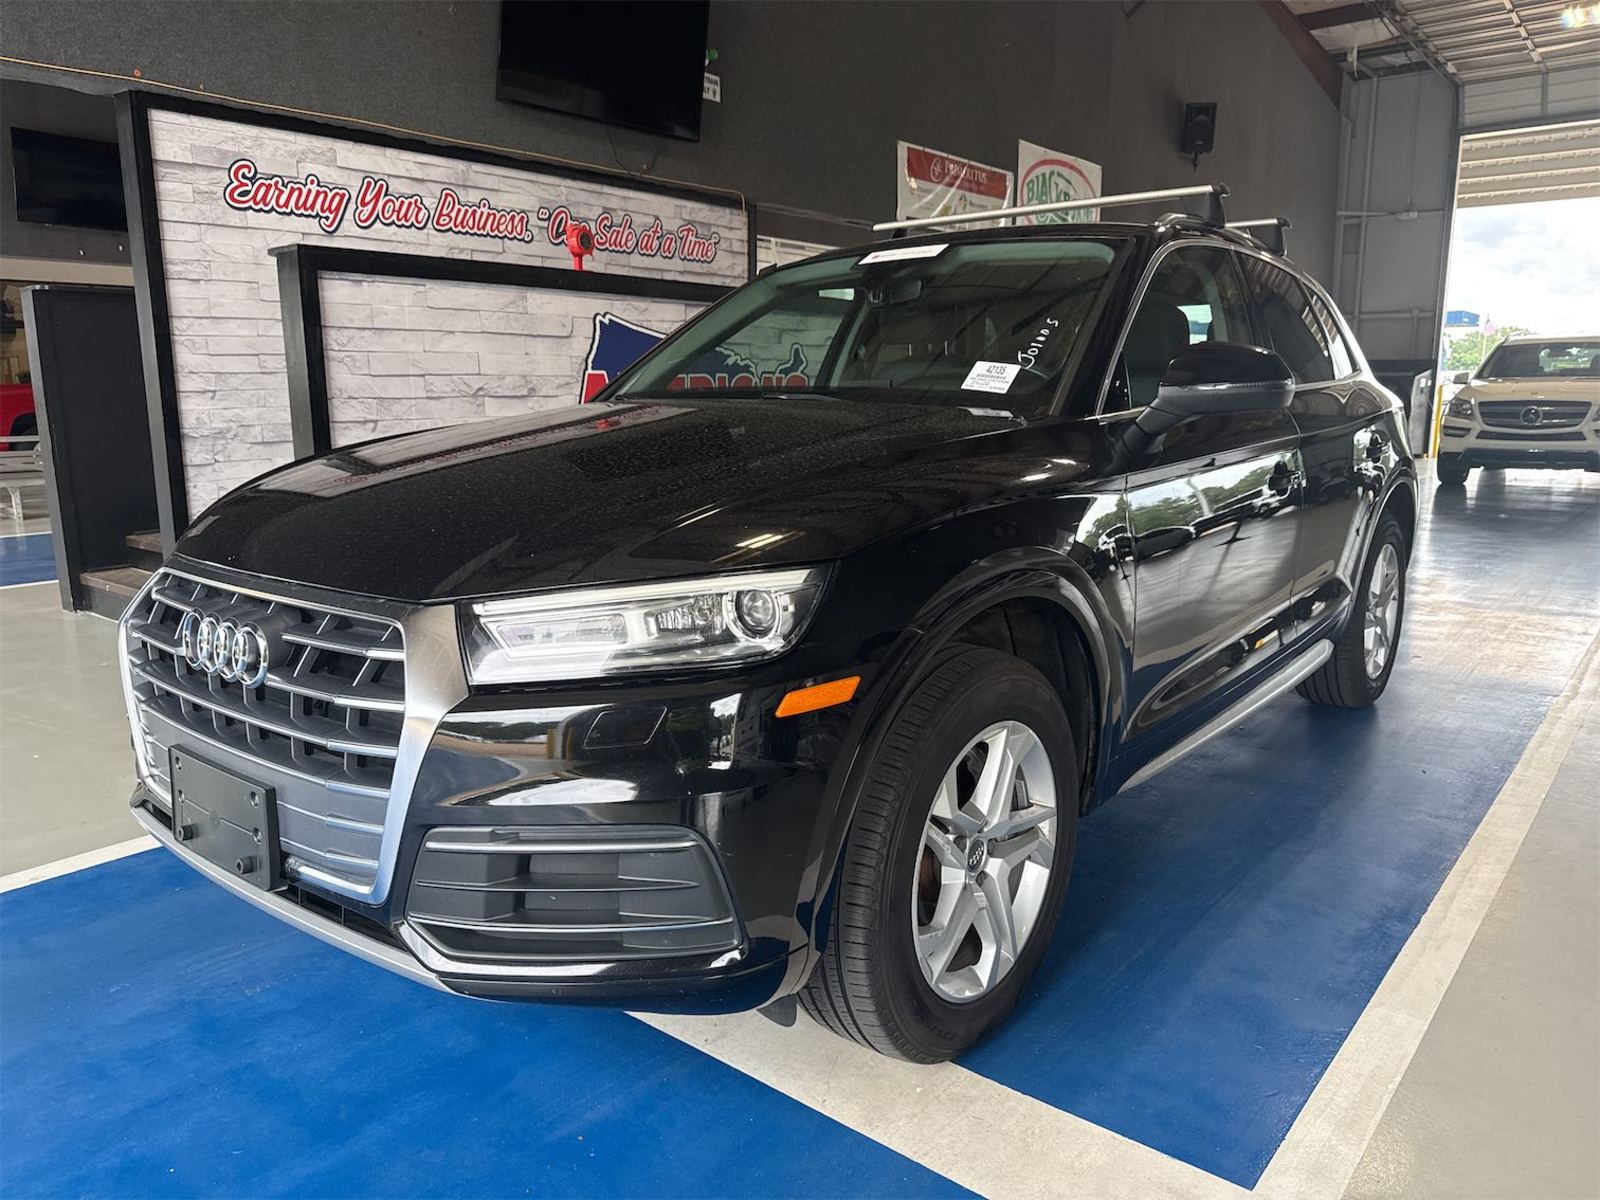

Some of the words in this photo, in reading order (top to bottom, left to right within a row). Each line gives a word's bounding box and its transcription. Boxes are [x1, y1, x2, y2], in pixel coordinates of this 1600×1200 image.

[225, 160, 349, 234] Earning
[355, 176, 428, 229] Your
[594, 212, 636, 254] Sale
[638, 218, 662, 257] at
[661, 233, 677, 257] a
